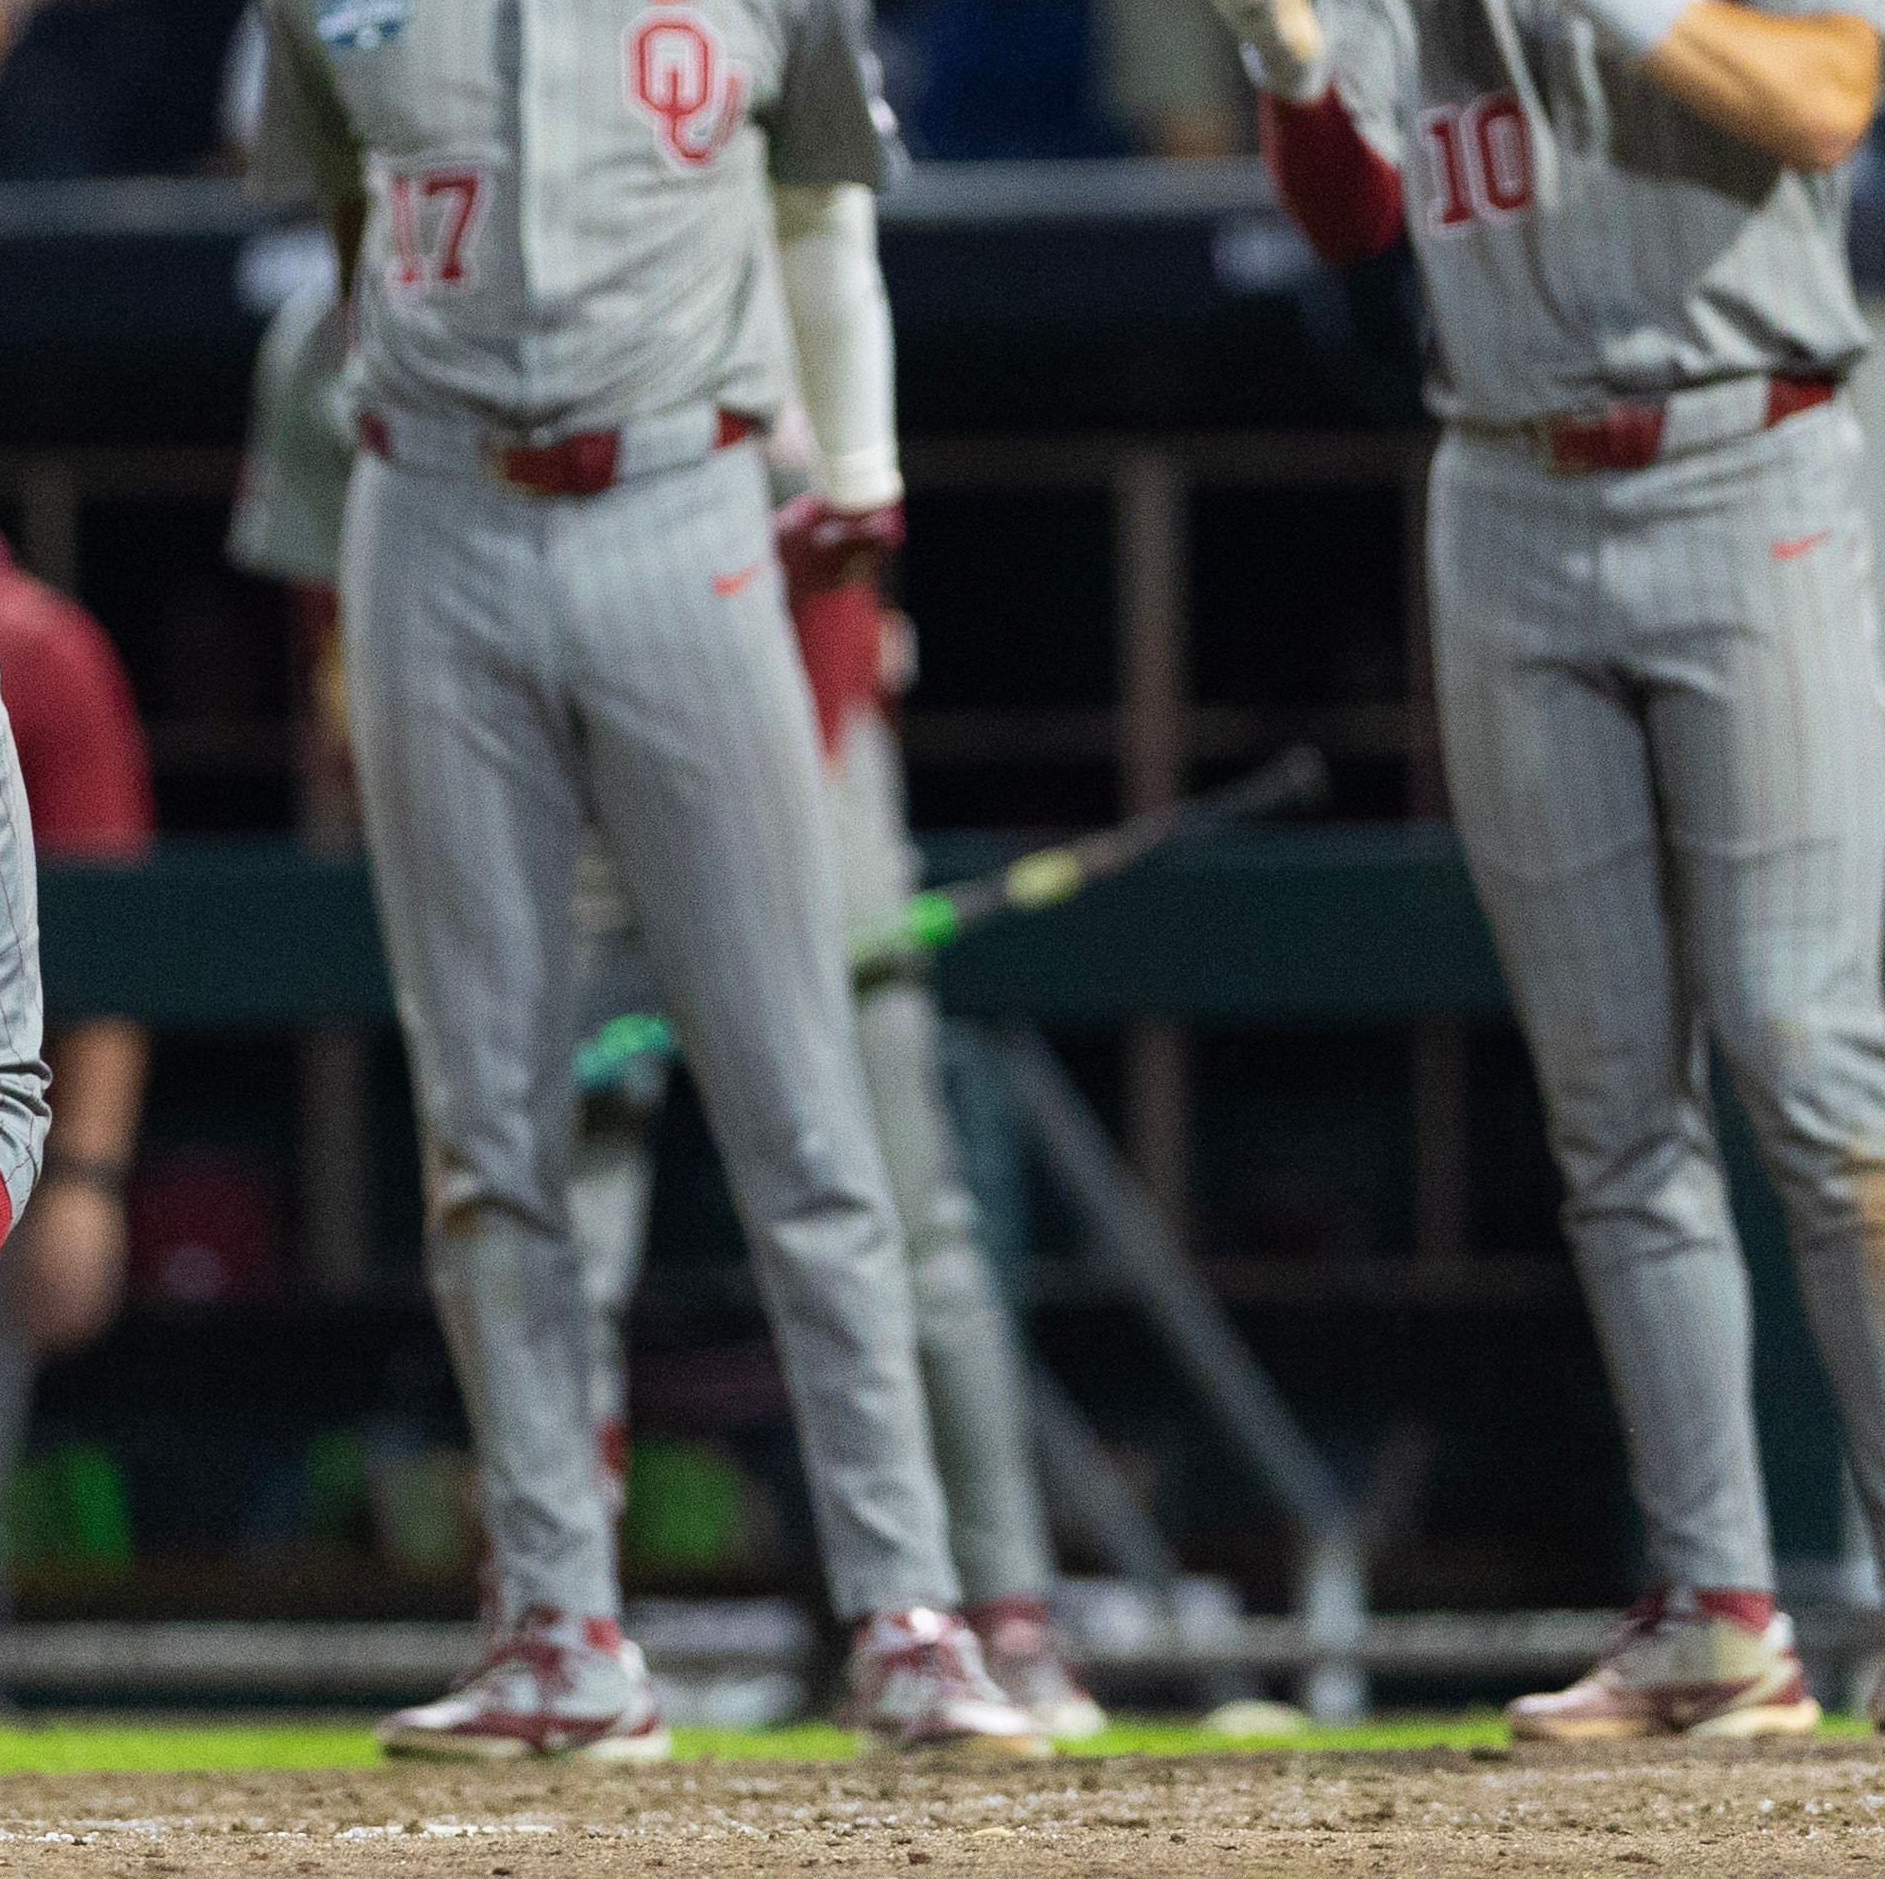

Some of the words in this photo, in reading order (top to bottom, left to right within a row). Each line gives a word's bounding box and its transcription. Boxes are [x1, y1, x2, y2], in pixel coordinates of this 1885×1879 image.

[623, 8, 748, 172] OU
[376, 168, 485, 288] 17
[1421, 94, 1535, 228] 10
